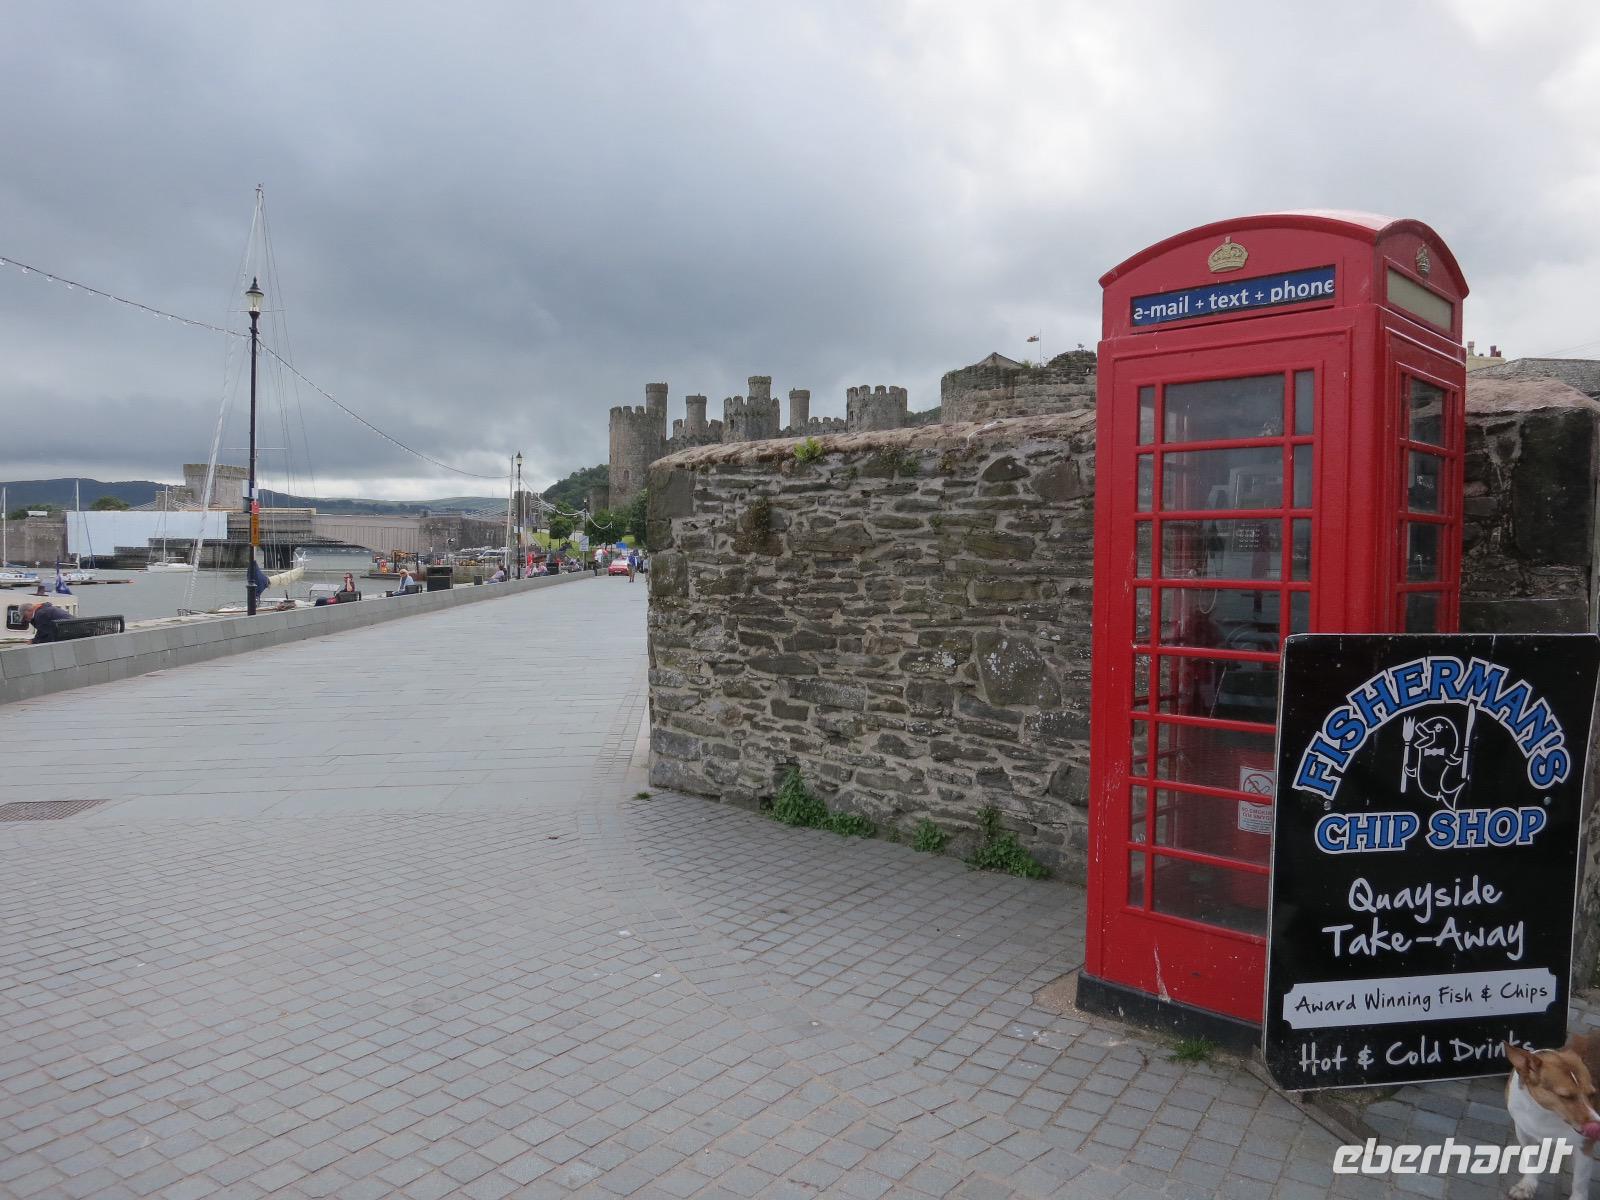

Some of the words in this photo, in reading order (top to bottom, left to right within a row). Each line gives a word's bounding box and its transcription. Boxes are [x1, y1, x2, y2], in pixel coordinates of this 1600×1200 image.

[1209, 288, 1249, 310] text
[1270, 279, 1335, 303] phone
[1292, 656, 1571, 800] FISHERMAN'S
[1314, 811, 1419, 854] CHIP
[1425, 806, 1547, 849] SHOP
[1348, 874, 1503, 923] Quayside
[1321, 917, 1524, 960] Take-Away
[1294, 993, 1356, 1014] Award
[1364, 987, 1431, 1013] Winning
[1438, 983, 1473, 1004] Fish
[1480, 984, 1492, 1000] &
[1500, 981, 1549, 1004] Chips
[1298, 1041, 1348, 1075] Hot
[1357, 1044, 1375, 1070] &
[1385, 1035, 1442, 1066] Cold
